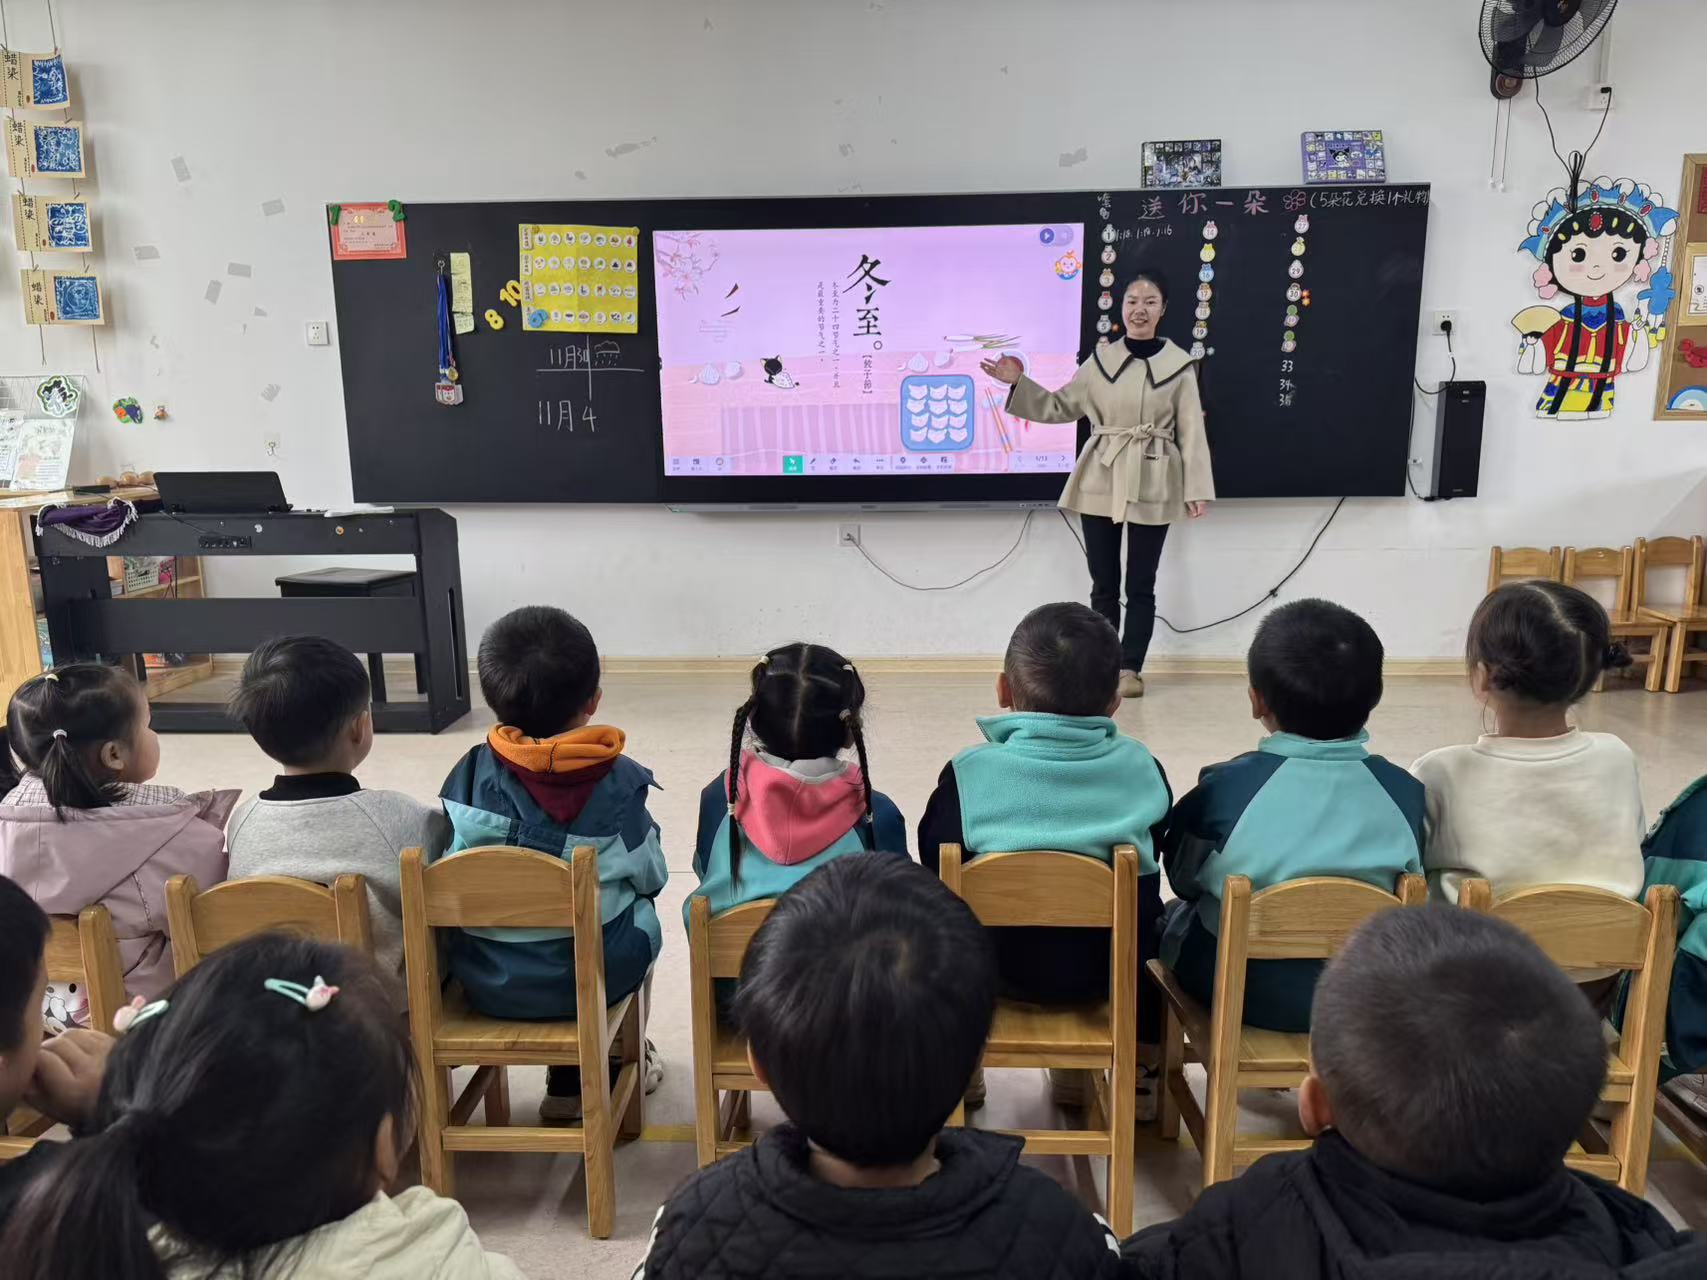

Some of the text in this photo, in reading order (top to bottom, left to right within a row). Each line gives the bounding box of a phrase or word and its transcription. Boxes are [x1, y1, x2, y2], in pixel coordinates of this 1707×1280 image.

[388, 199, 407, 222] 2
[1138, 190, 1269, 220] 送你一朵
[1292, 267, 1301, 275] 29
[1290, 290, 1299, 298] 30
[485, 309, 504, 330] 8
[1281, 360, 1293, 372] 33
[538, 400, 597, 432] 11月 4
